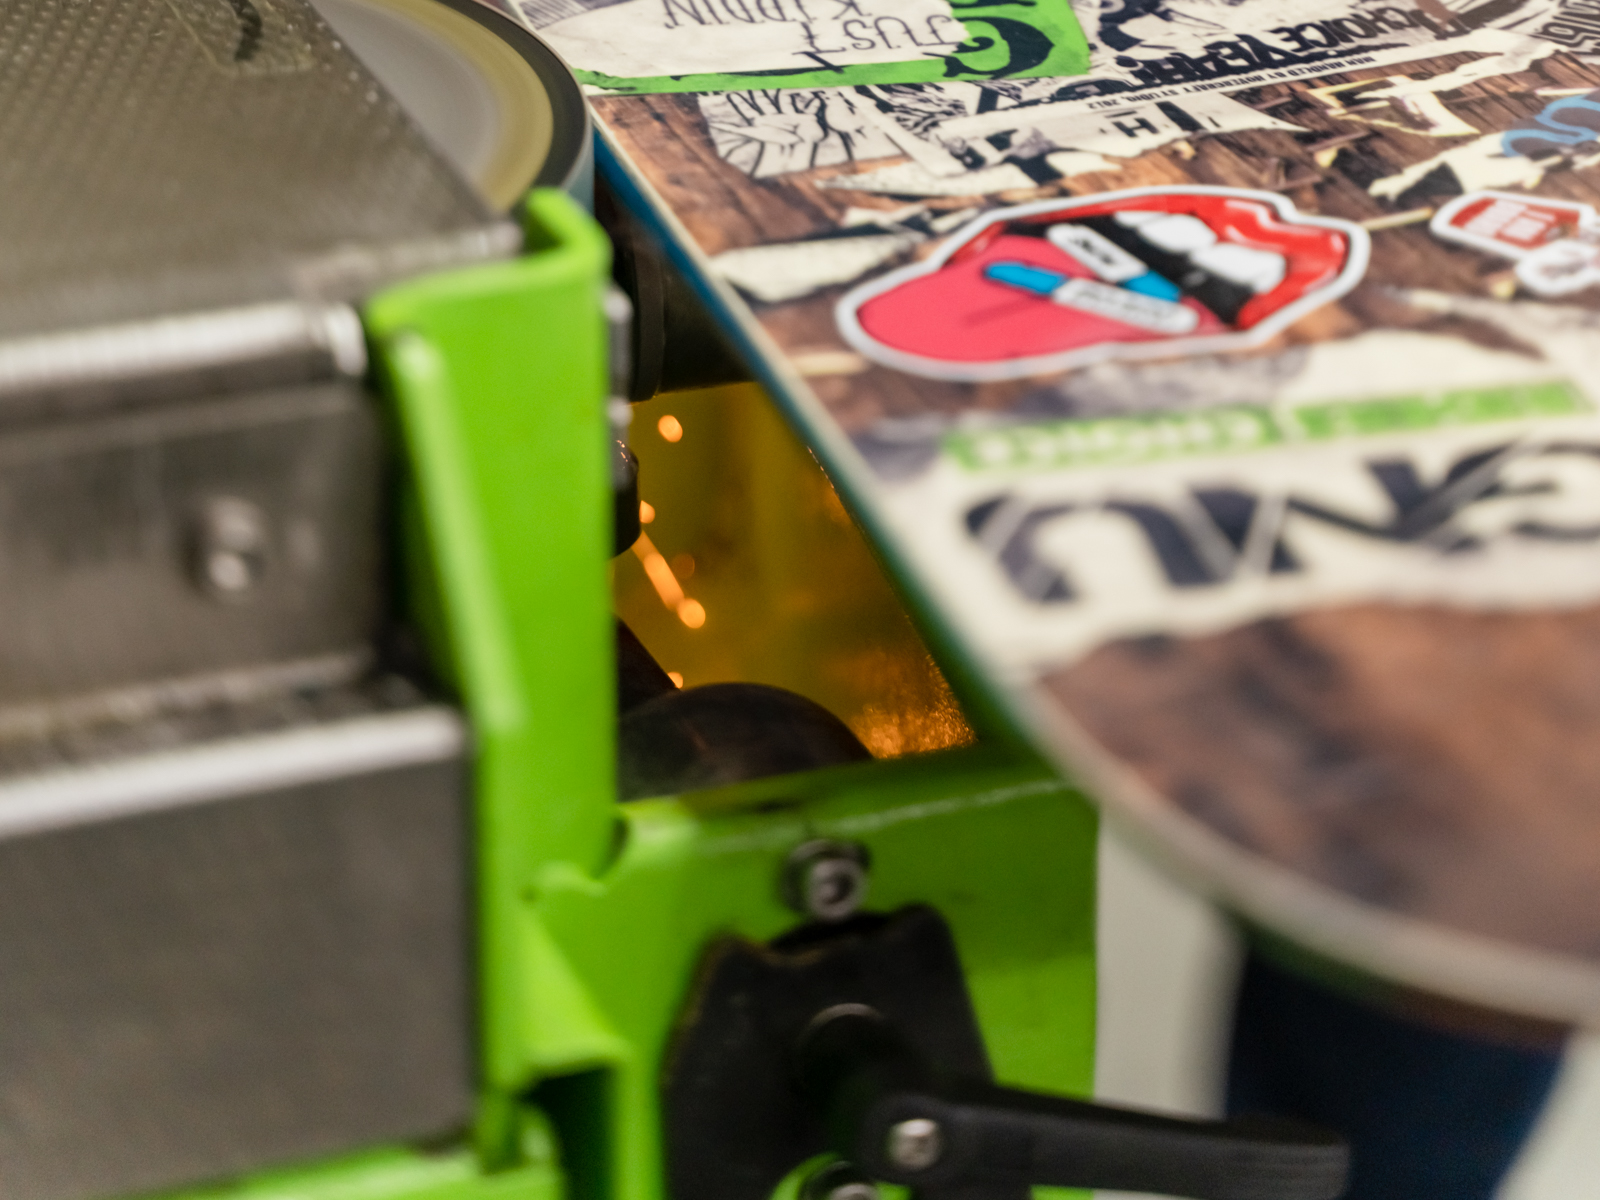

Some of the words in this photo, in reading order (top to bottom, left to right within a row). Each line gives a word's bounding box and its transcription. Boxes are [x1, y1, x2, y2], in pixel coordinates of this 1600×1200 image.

[792, 15, 961, 55] JUST
[1346, 56, 1375, 65] MAN
[1267, 71, 1286, 80] BY
[1289, 61, 1343, 77] HANDLED
[1182, 74, 1265, 93] HOVERCRAFT
